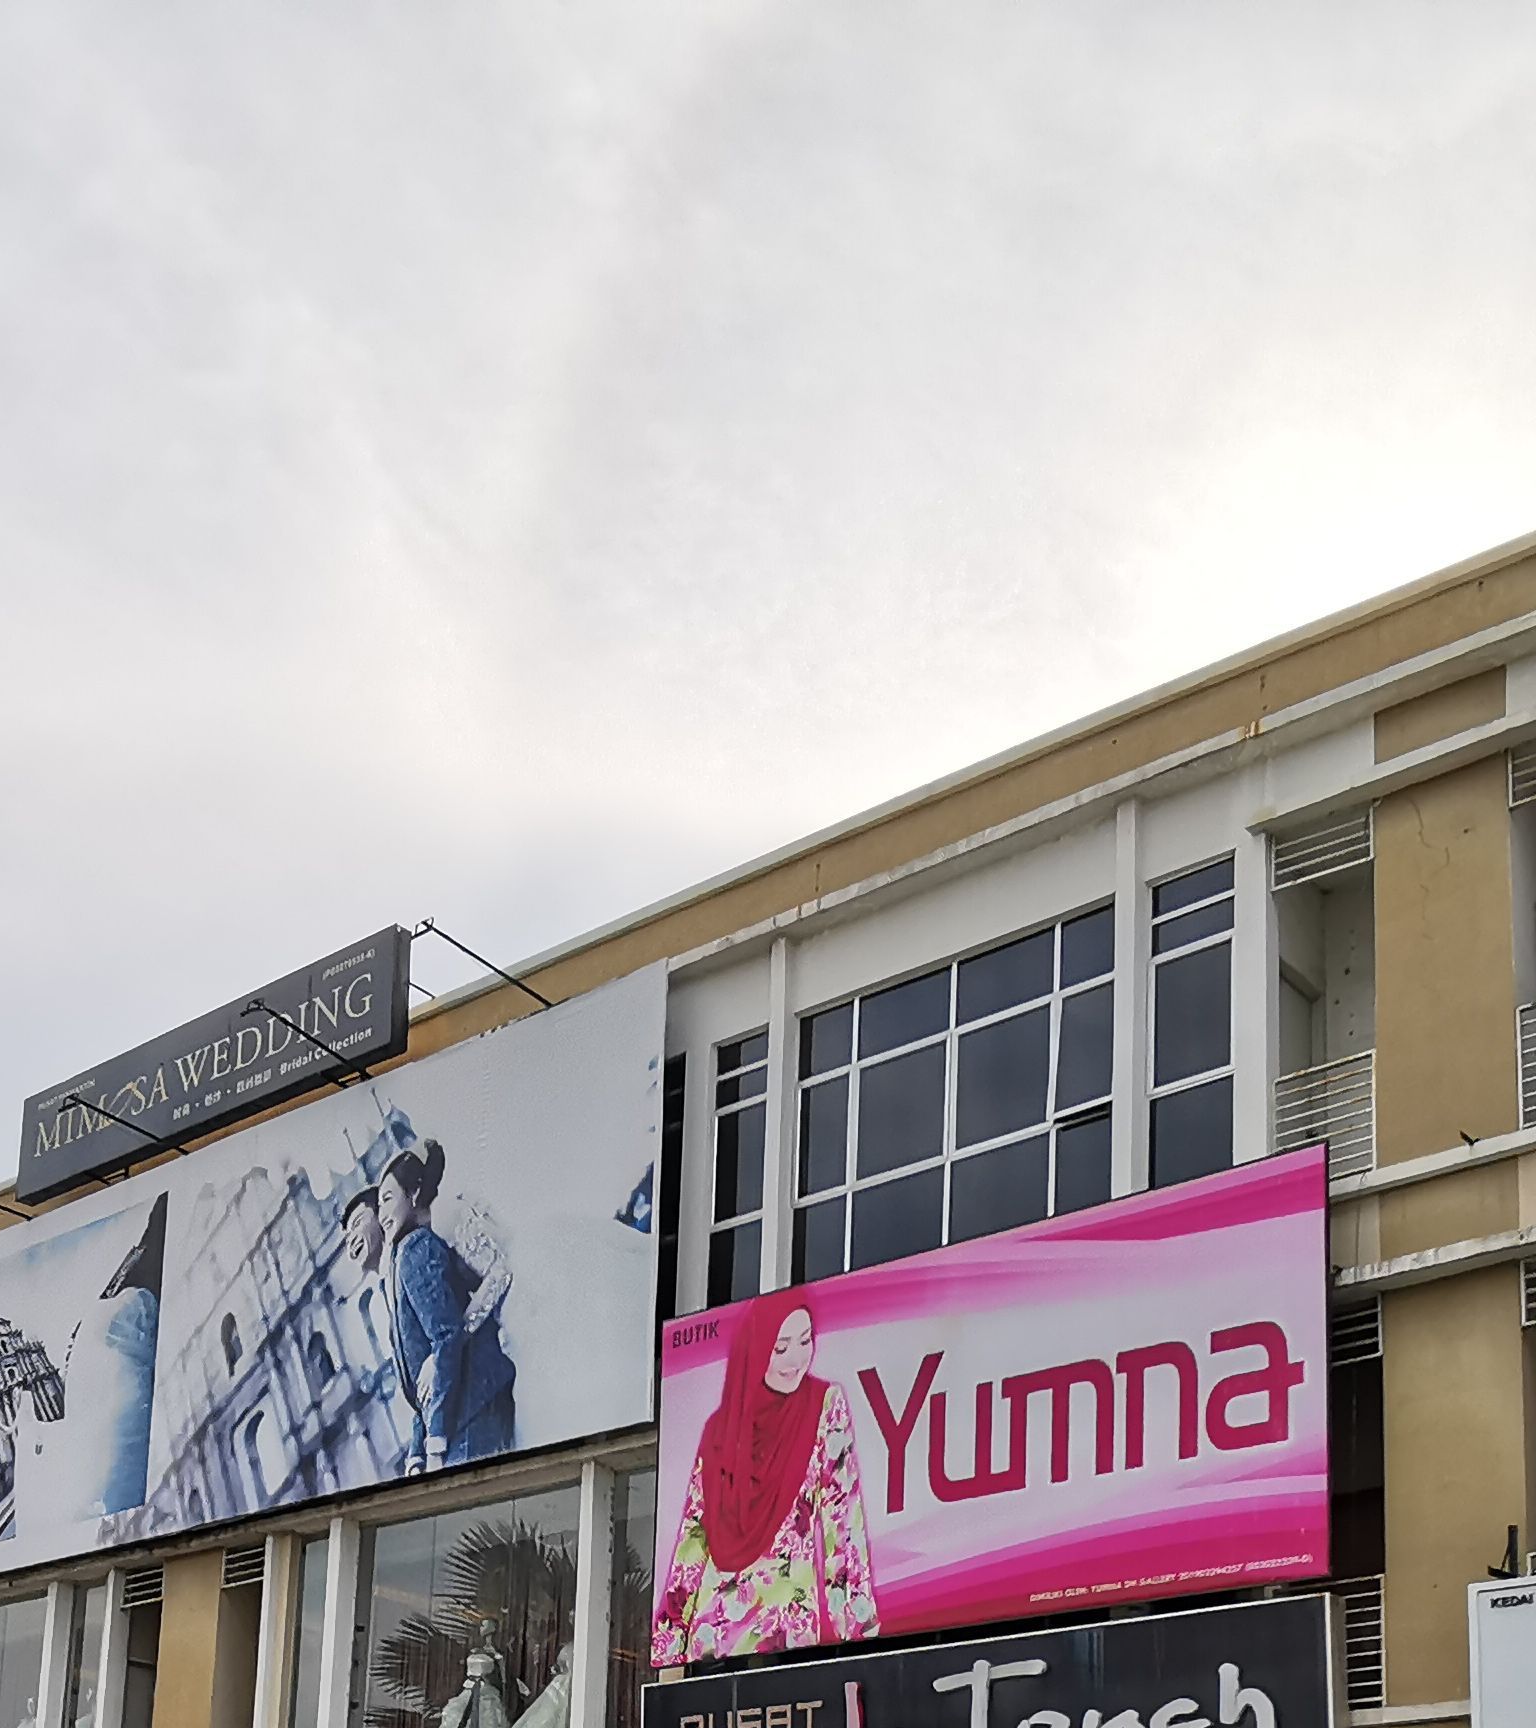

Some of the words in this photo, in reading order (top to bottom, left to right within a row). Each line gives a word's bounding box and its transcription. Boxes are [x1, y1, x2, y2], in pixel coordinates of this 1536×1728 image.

[34, 1067, 169, 1158] MIMOSA
[173, 972, 373, 1094] WEDDING
[280, 1051, 312, 1075] Bridal
[671, 1319, 720, 1351] BUTIK
[857, 1321, 1305, 1516] Yumna
